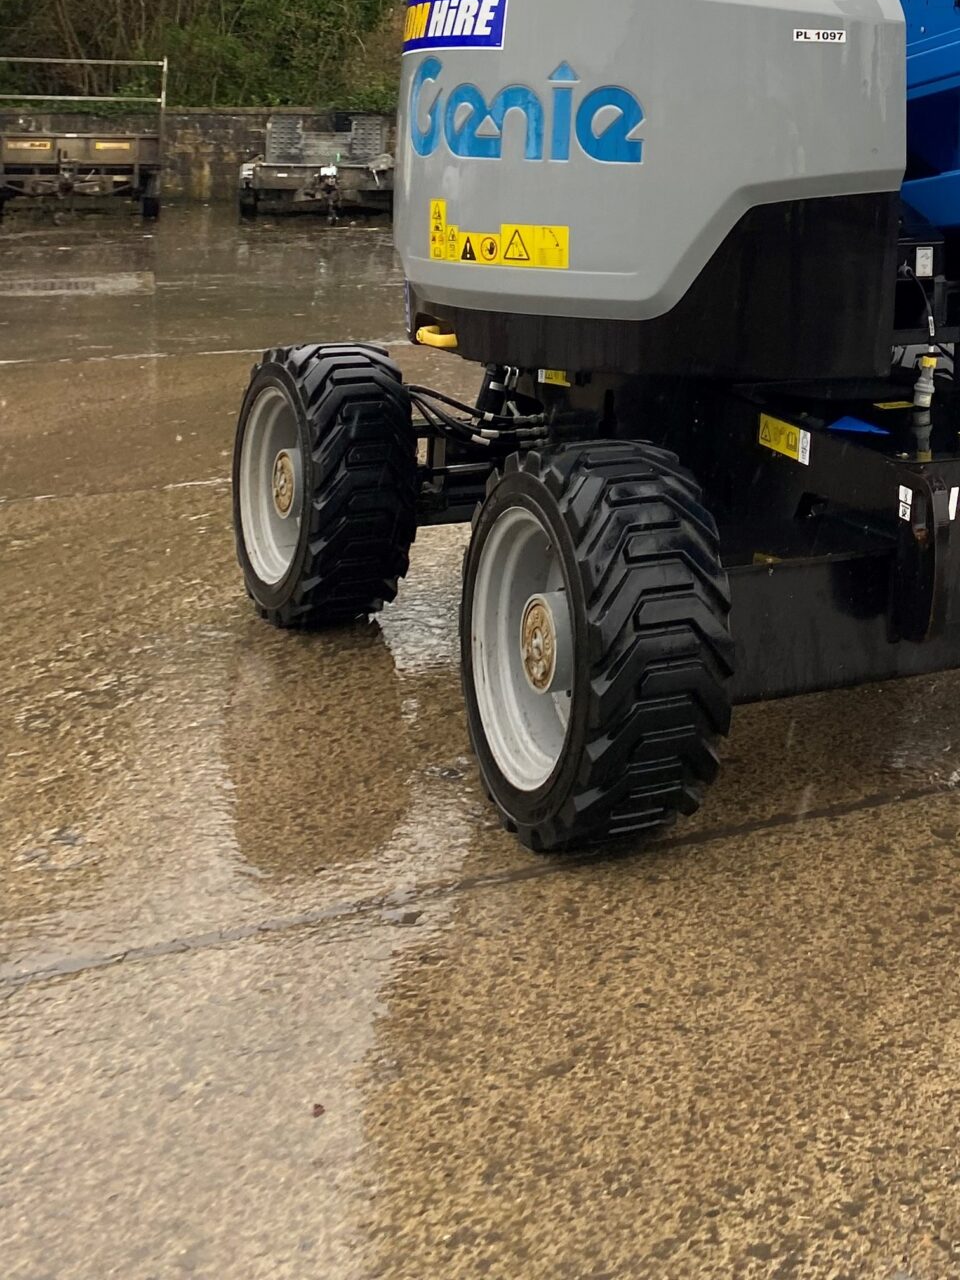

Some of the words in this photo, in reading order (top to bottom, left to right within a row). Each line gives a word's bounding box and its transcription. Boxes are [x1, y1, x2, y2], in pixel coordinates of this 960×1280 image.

[796, 31, 811, 40] PL
[815, 31, 844, 41] 1097
[411, 56, 646, 163] Genie
